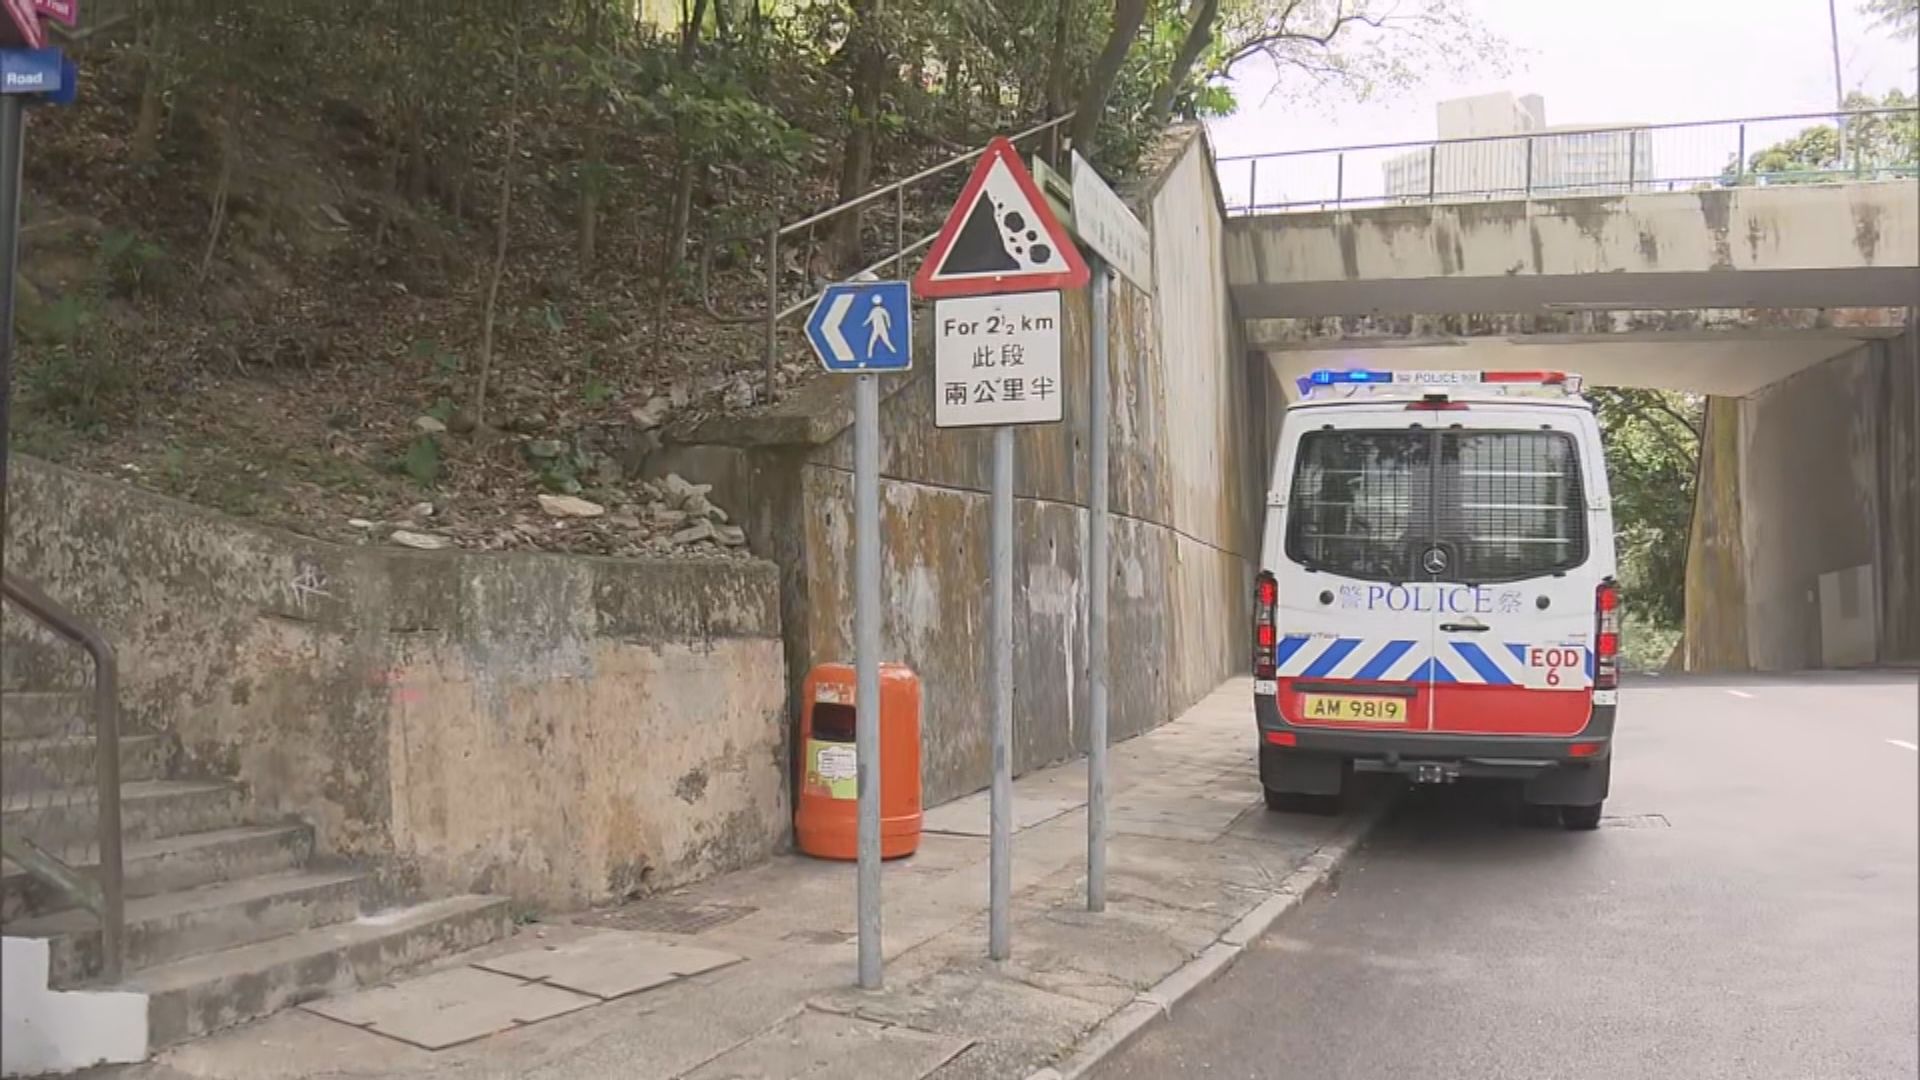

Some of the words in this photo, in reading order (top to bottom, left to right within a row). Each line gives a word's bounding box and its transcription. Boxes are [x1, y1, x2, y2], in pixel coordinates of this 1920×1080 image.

[7, 71, 43, 85] Road
[944, 318, 979, 337] For
[1021, 314, 1053, 331] km
[972, 344, 1025, 368] 此段
[1415, 373, 1457, 383] POLICE
[944, 376, 1055, 405] 兩公里半
[1368, 585, 1493, 614] POLICE
[1531, 648, 1579, 667] EOD
[1546, 668, 1560, 686] 6
[1314, 698, 1341, 715] AM
[1350, 700, 1397, 718] 9819
